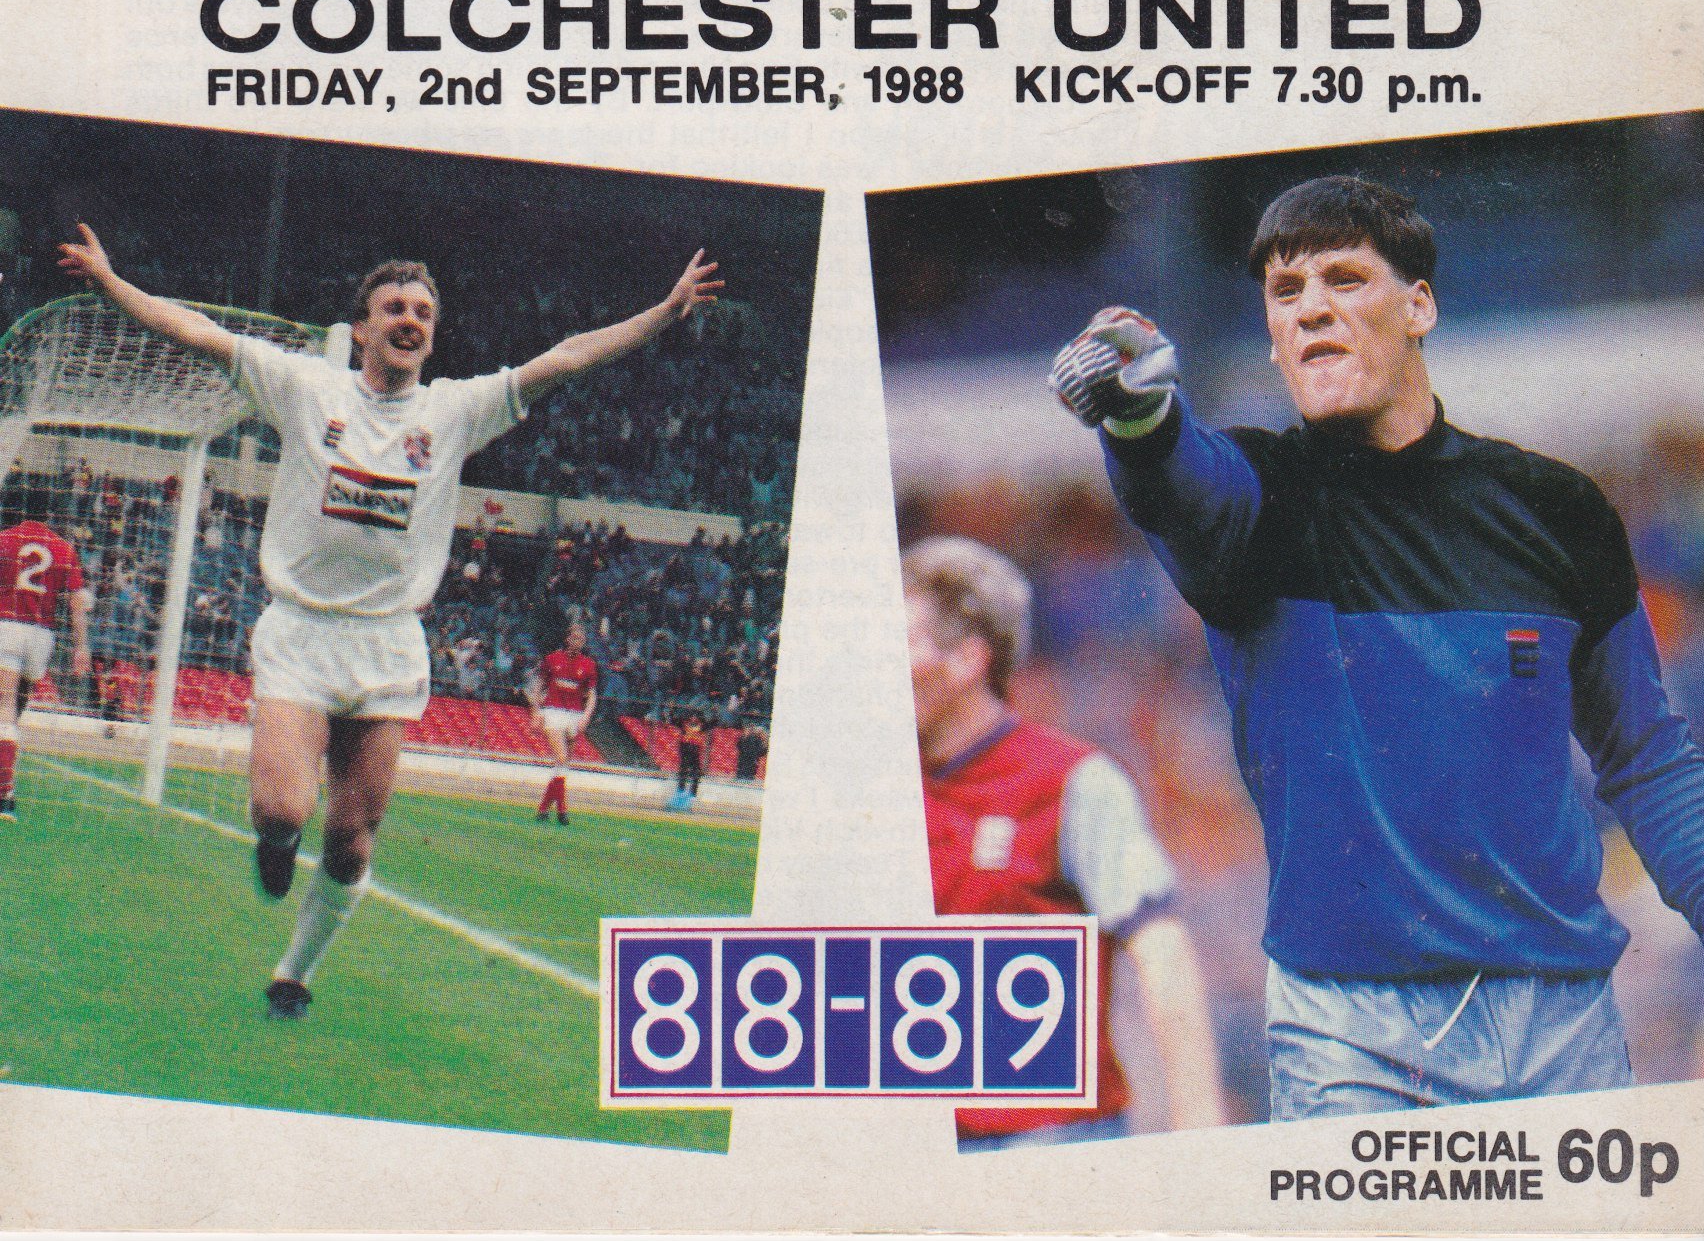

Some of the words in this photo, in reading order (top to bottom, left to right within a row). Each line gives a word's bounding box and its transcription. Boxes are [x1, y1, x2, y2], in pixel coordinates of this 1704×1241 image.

[208, 69, 395, 112] FRIDAY,
[420, 68, 501, 105] 2nd
[527, 66, 838, 109] SEPTEMBER,
[864, 66, 963, 103] 1988
[1016, 65, 1251, 103] KICK-OFF
[1273, 66, 1362, 103] 7.30
[1389, 75, 1480, 112] p.m.
[16, 542, 54, 594] 2
[630, 954, 1066, 1073] 88-89
[1352, 1131, 1539, 1162] OFFICIAL
[1558, 1129, 1679, 1196] 60p
[1271, 1170, 1542, 1200] PROGRAMME
